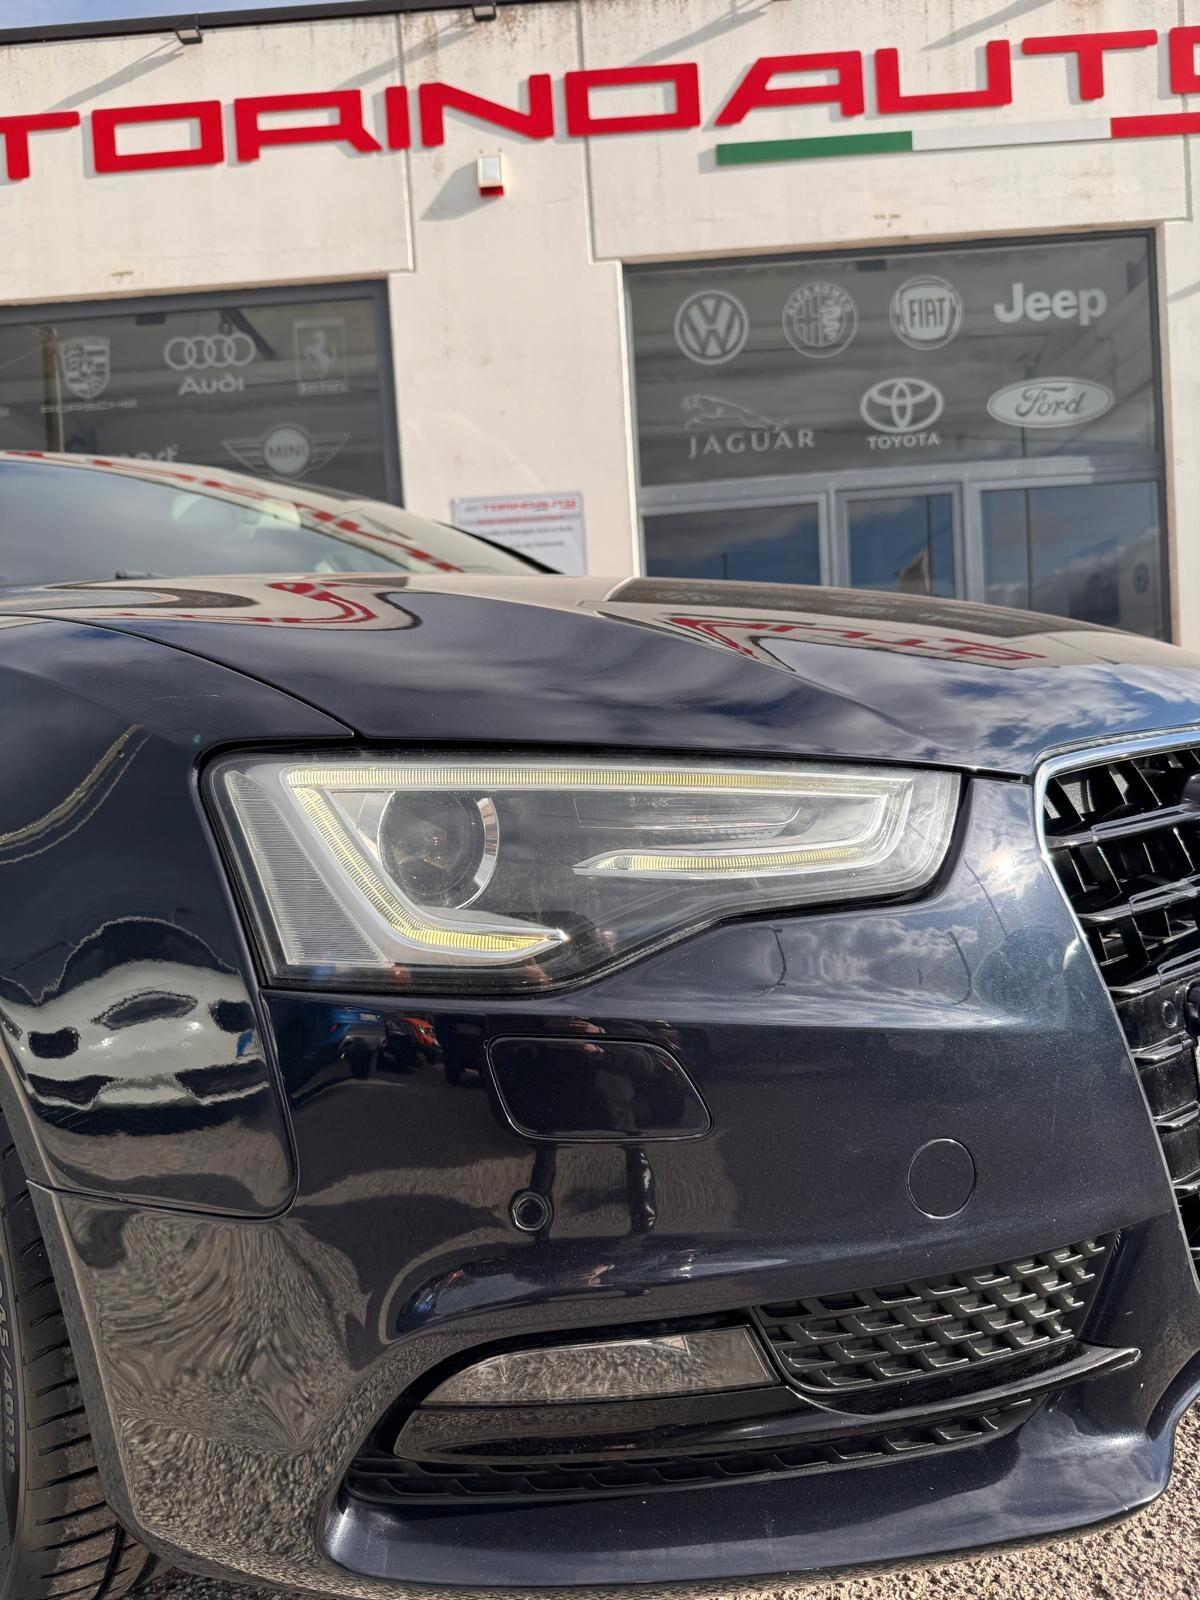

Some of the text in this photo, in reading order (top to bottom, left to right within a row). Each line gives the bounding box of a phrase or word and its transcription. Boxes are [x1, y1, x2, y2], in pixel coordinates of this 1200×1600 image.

[0, 25, 1200, 180] TORINOAUT
[909, 298, 947, 329] FIAT
[993, 282, 1107, 326] Jeep
[177, 375, 245, 396] Audi
[1014, 386, 1086, 419] Ford
[269, 443, 305, 457] MINI
[689, 430, 815, 459] JAGUAR
[866, 431, 941, 450] TOYOTA
